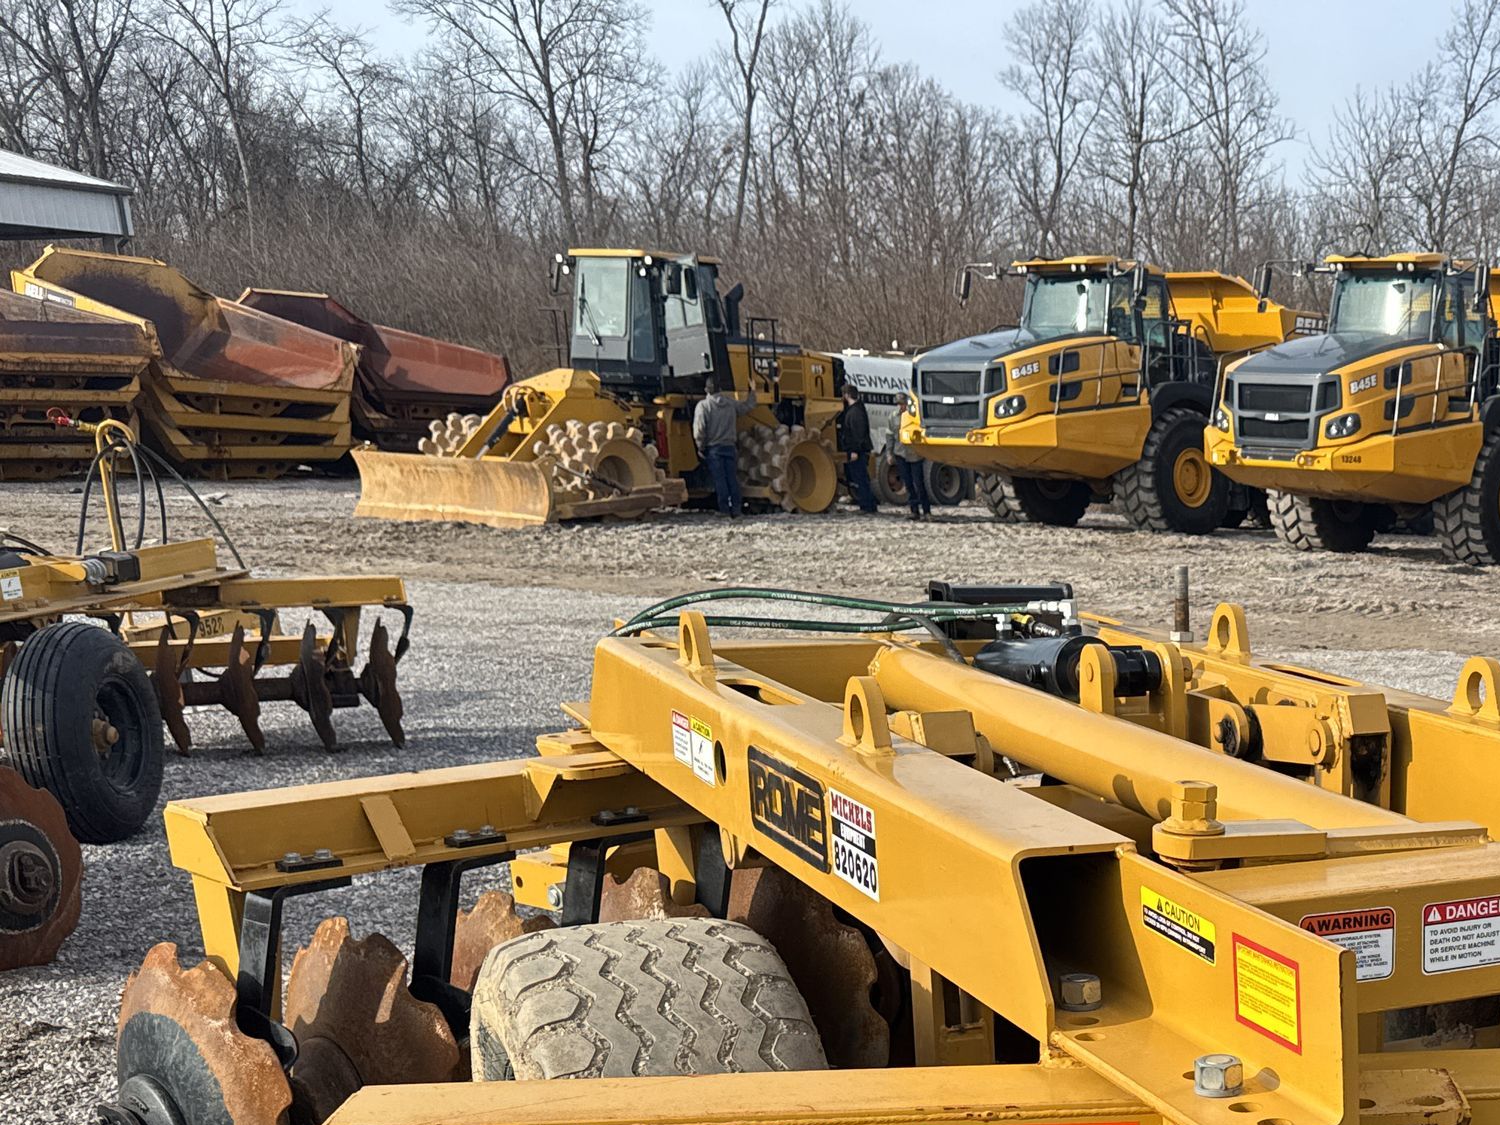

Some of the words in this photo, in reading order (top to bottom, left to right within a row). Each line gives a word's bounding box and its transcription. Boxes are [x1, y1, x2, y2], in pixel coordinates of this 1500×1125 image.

[1011, 361, 1039, 380] B45E
[846, 373, 910, 391] NEWMAN
[1349, 374, 1377, 395] B45E
[750, 757, 824, 851] ROME
[831, 791, 873, 834] MICHELS
[840, 823, 866, 849] EQUIPMENT
[834, 839, 877, 893] 820620
[1164, 900, 1200, 932] CAUTION
[1317, 912, 1391, 933] WARNING
[1430, 937, 1450, 945] DEATH
[1476, 930, 1499, 939] ADJUST
[1440, 927, 1458, 935] AVOID
[1460, 924, 1480, 932] INJURY
[1430, 955, 1449, 963] WHILE
[1459, 951, 1481, 959] MOTION
[1441, 944, 1466, 953] SERVICE
[1468, 940, 1495, 949] MACHINE
